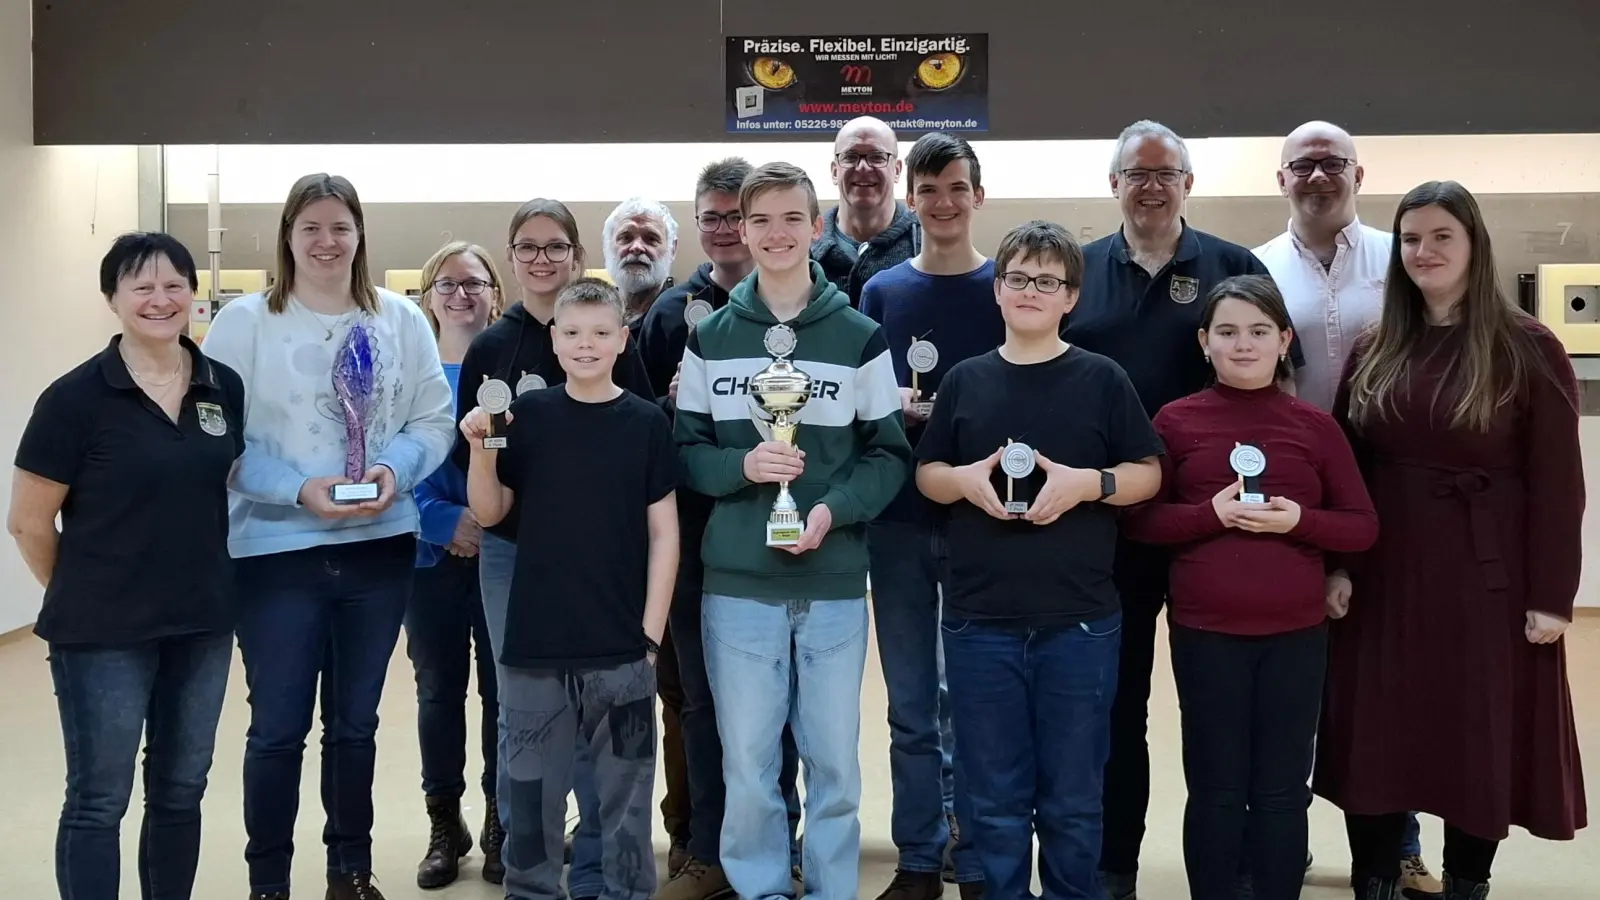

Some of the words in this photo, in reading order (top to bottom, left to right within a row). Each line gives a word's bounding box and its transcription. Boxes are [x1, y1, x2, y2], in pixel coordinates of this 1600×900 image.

[743, 38, 805, 53] Präzise.
[809, 38, 876, 53] Flexibel.
[880, 37, 970, 54] Einzigartig.
[875, 53, 897, 61] LICHT!
[799, 101, 914, 114] www.meyton.de
[736, 120, 760, 129] Infos
[763, 120, 792, 129] unter:
[1556, 222, 1573, 246] 7
